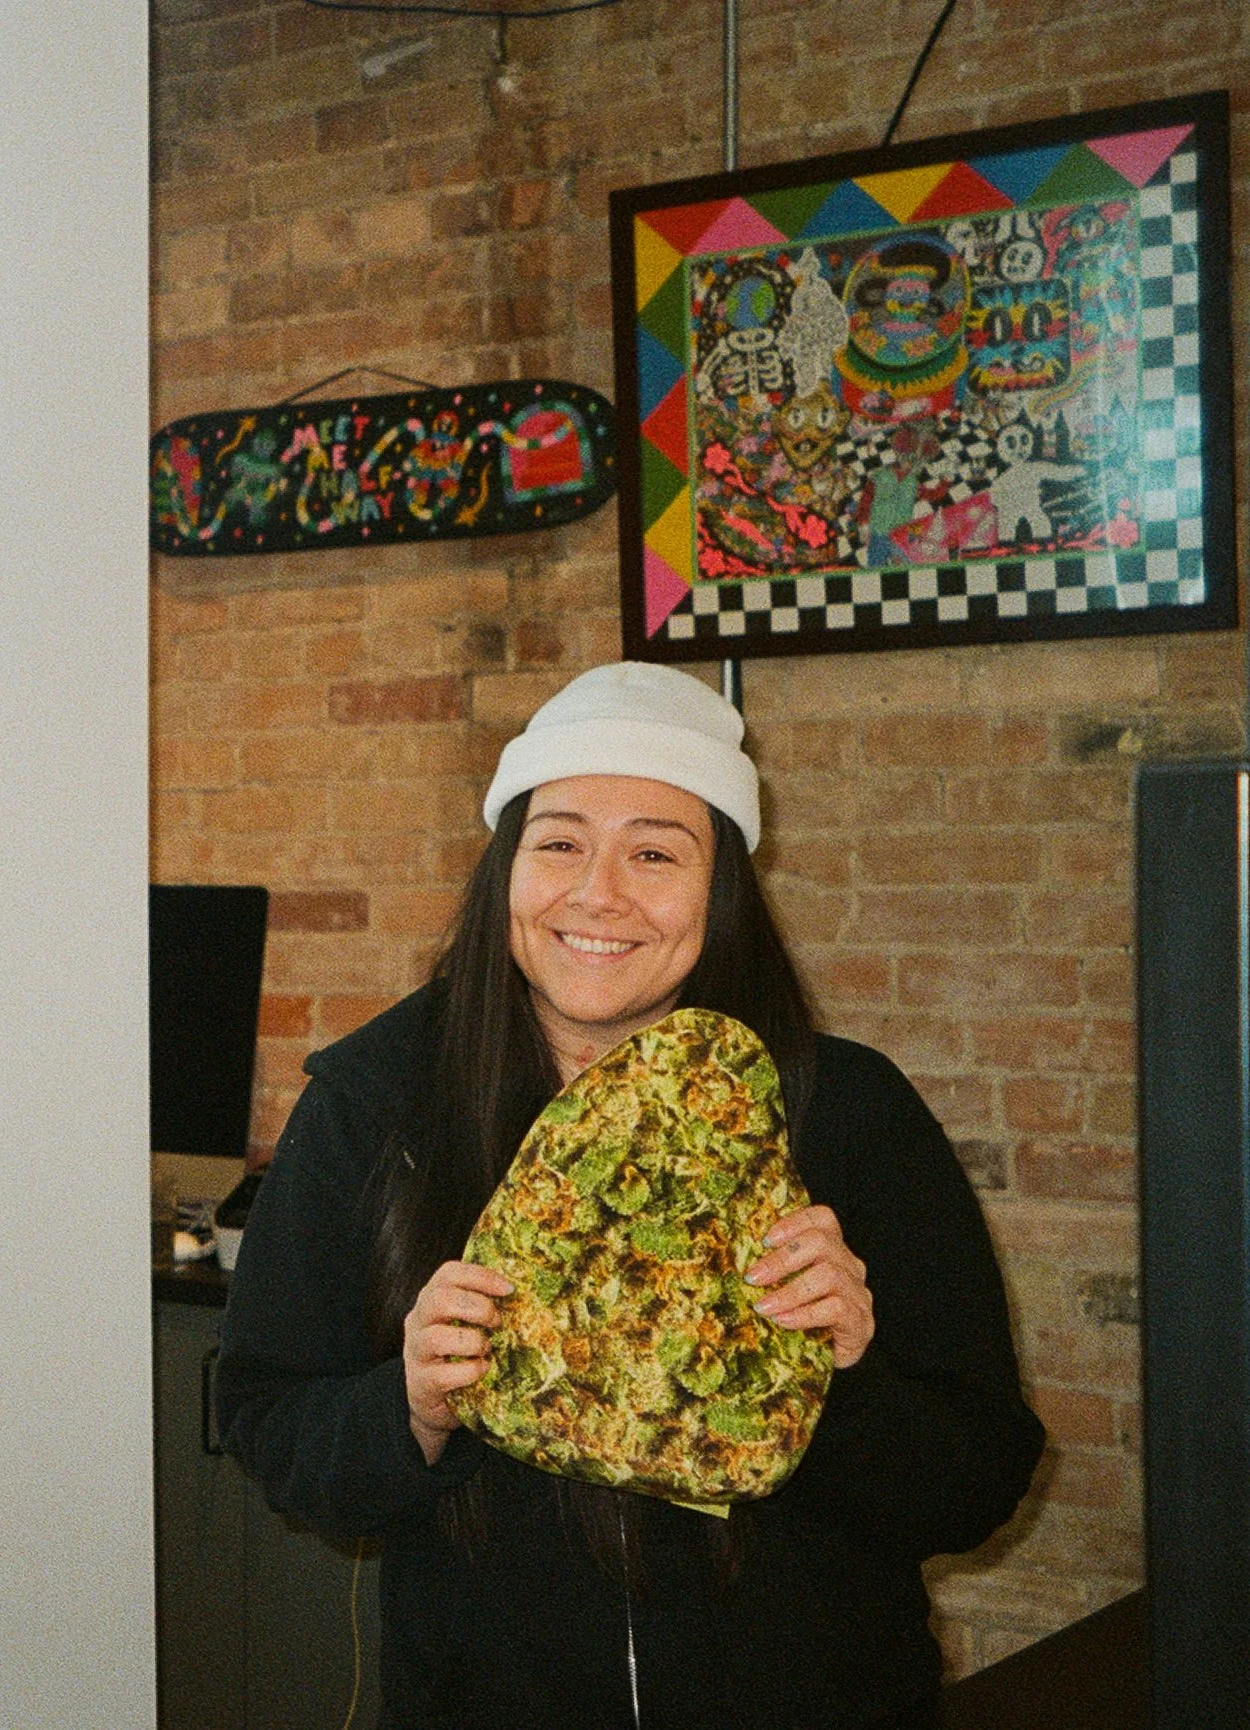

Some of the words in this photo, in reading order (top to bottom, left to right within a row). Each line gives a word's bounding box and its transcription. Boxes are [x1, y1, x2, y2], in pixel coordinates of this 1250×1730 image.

[290, 415, 372, 456] MEET
[318, 465, 393, 499] HALF
[331, 492, 396, 525] WAY
